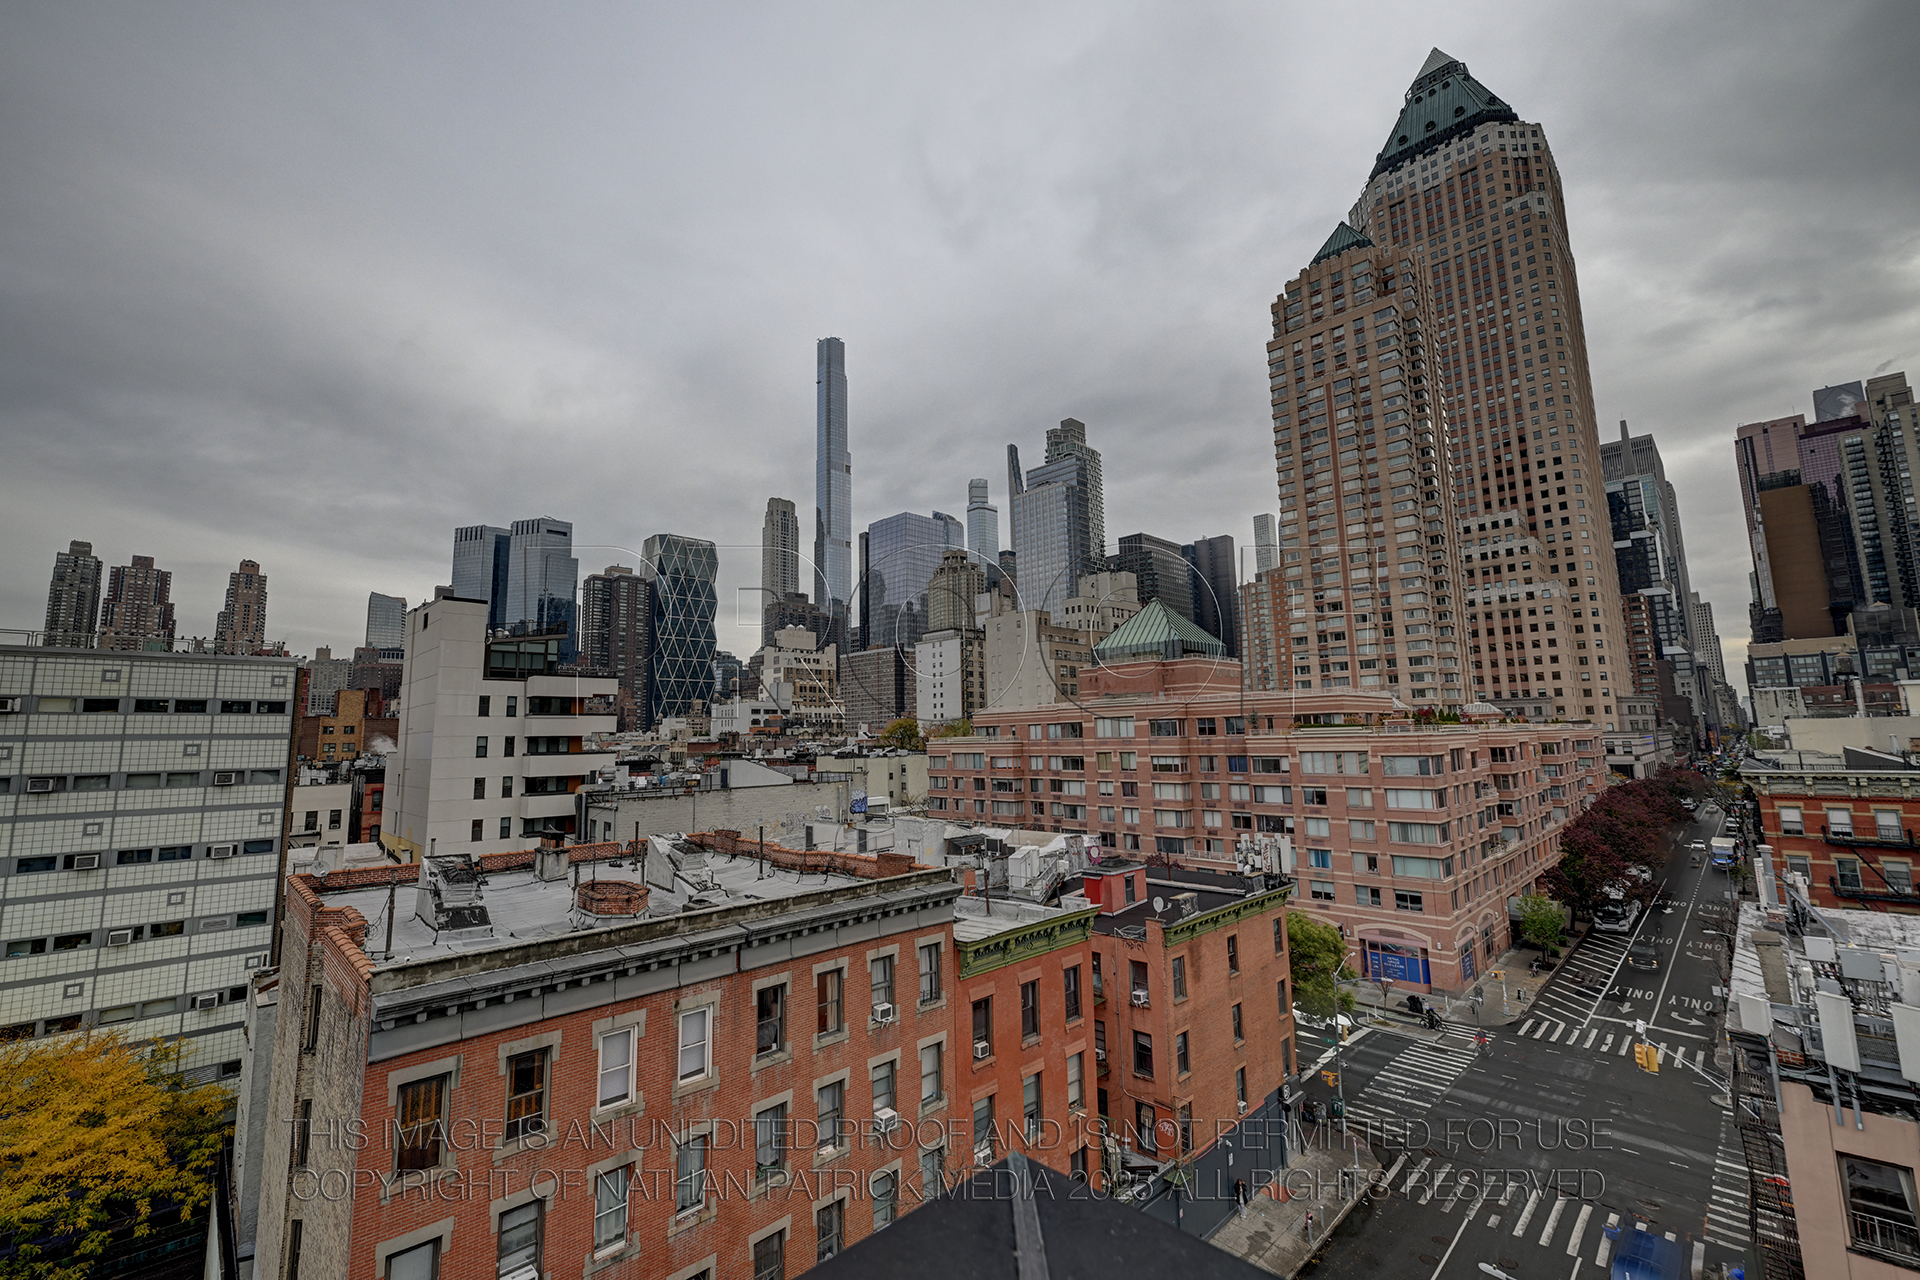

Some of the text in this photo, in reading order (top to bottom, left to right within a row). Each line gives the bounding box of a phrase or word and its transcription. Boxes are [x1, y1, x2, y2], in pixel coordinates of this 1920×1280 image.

[1655, 899, 1687, 907] ONLY
[1698, 903, 1730, 912] ONLY
[1636, 934, 1674, 945] ONLY
[1686, 940, 1722, 952] ONLY
[1608, 985, 1654, 1001] ONLY
[1668, 995, 1713, 1012] ONLY
